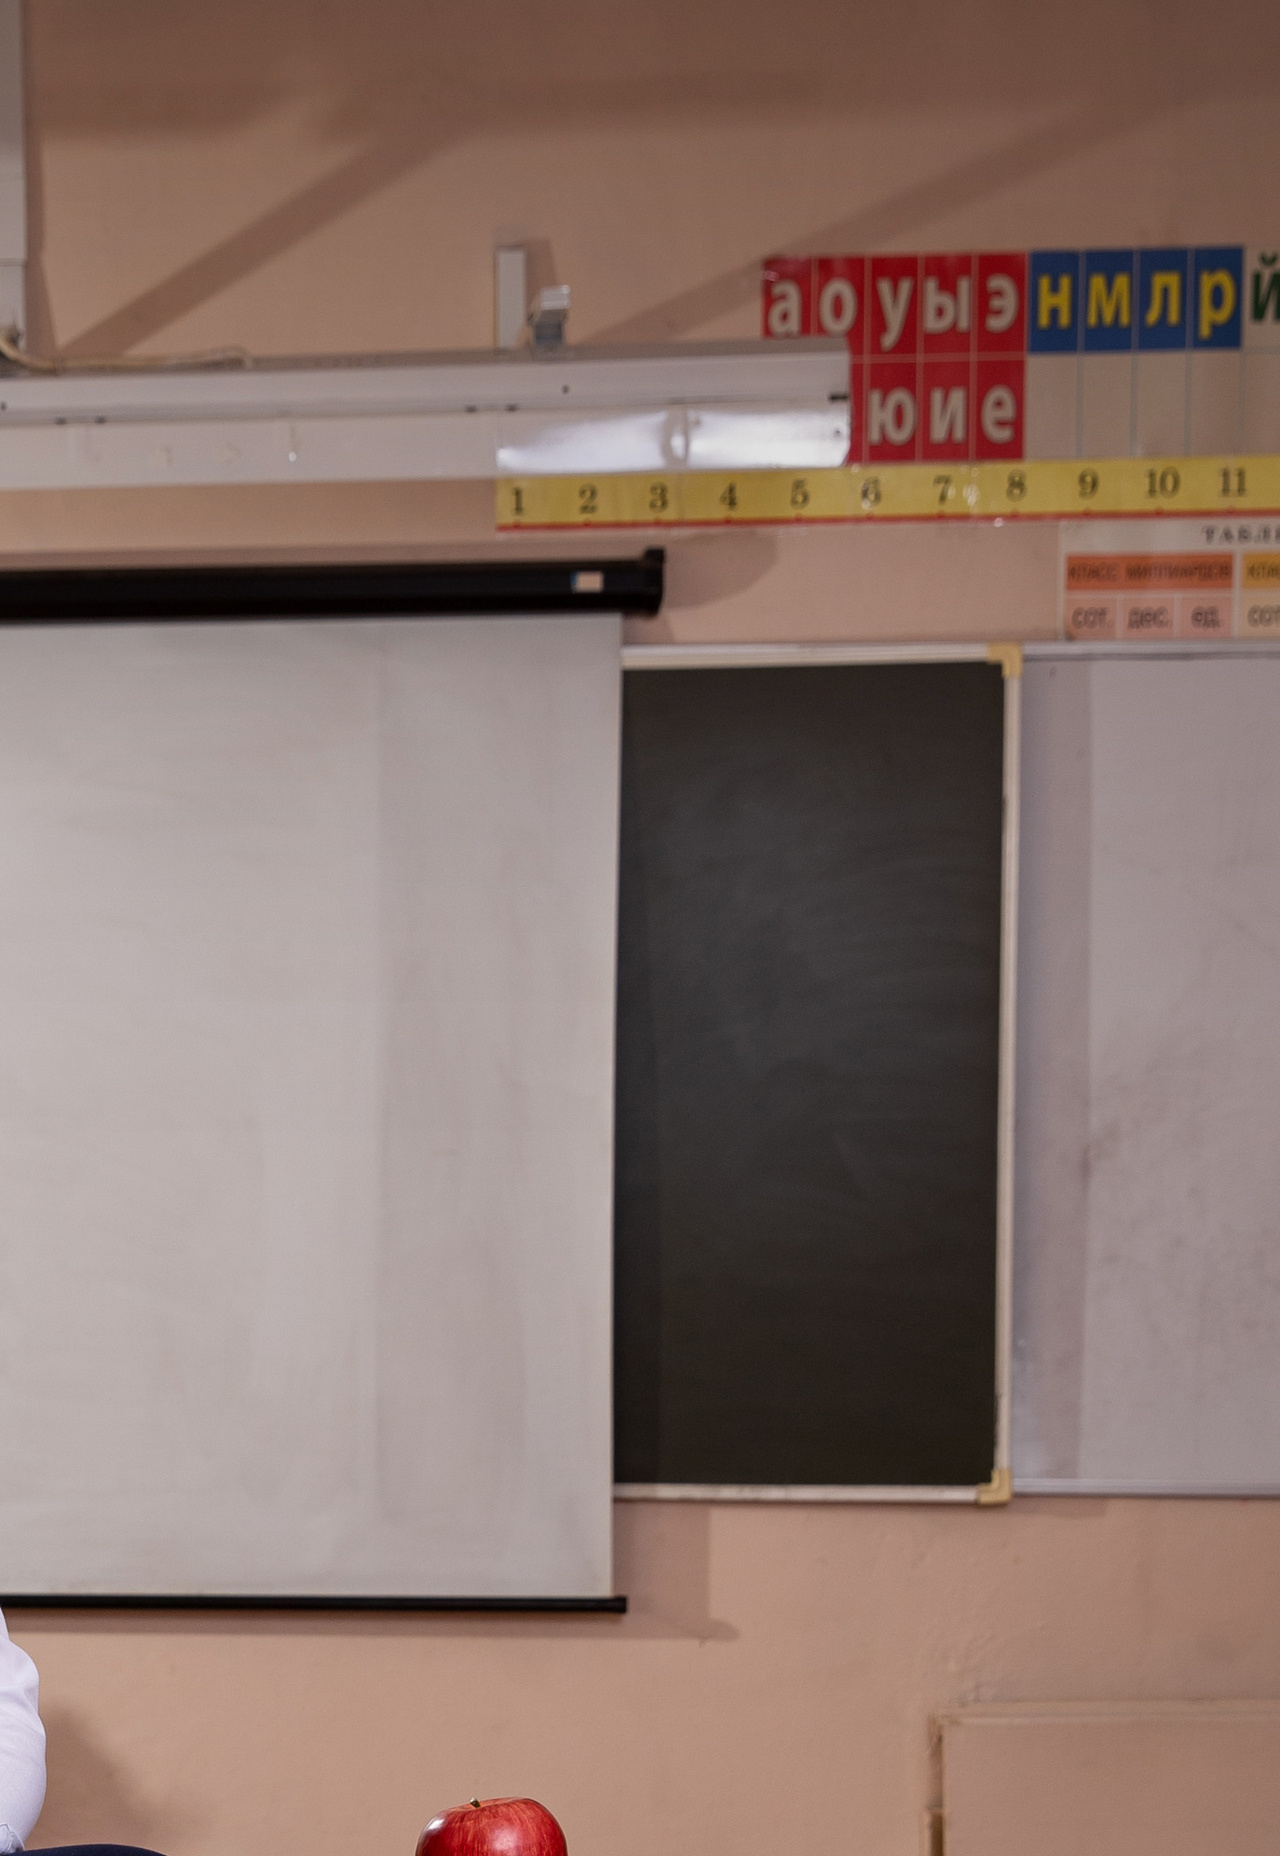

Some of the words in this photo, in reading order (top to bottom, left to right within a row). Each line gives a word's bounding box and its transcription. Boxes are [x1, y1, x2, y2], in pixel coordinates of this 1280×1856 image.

[511, 486, 525, 516] 1
[578, 483, 598, 514] 2
[649, 481, 668, 513] 3
[720, 480, 737, 512] 4
[790, 478, 810, 510] 5
[860, 476, 881, 508] 6
[933, 474, 953, 505] 7
[1006, 469, 1027, 502] 8
[1078, 467, 1099, 498] 9
[1145, 466, 1181, 498] 10
[1220, 466, 1248, 498] 11
